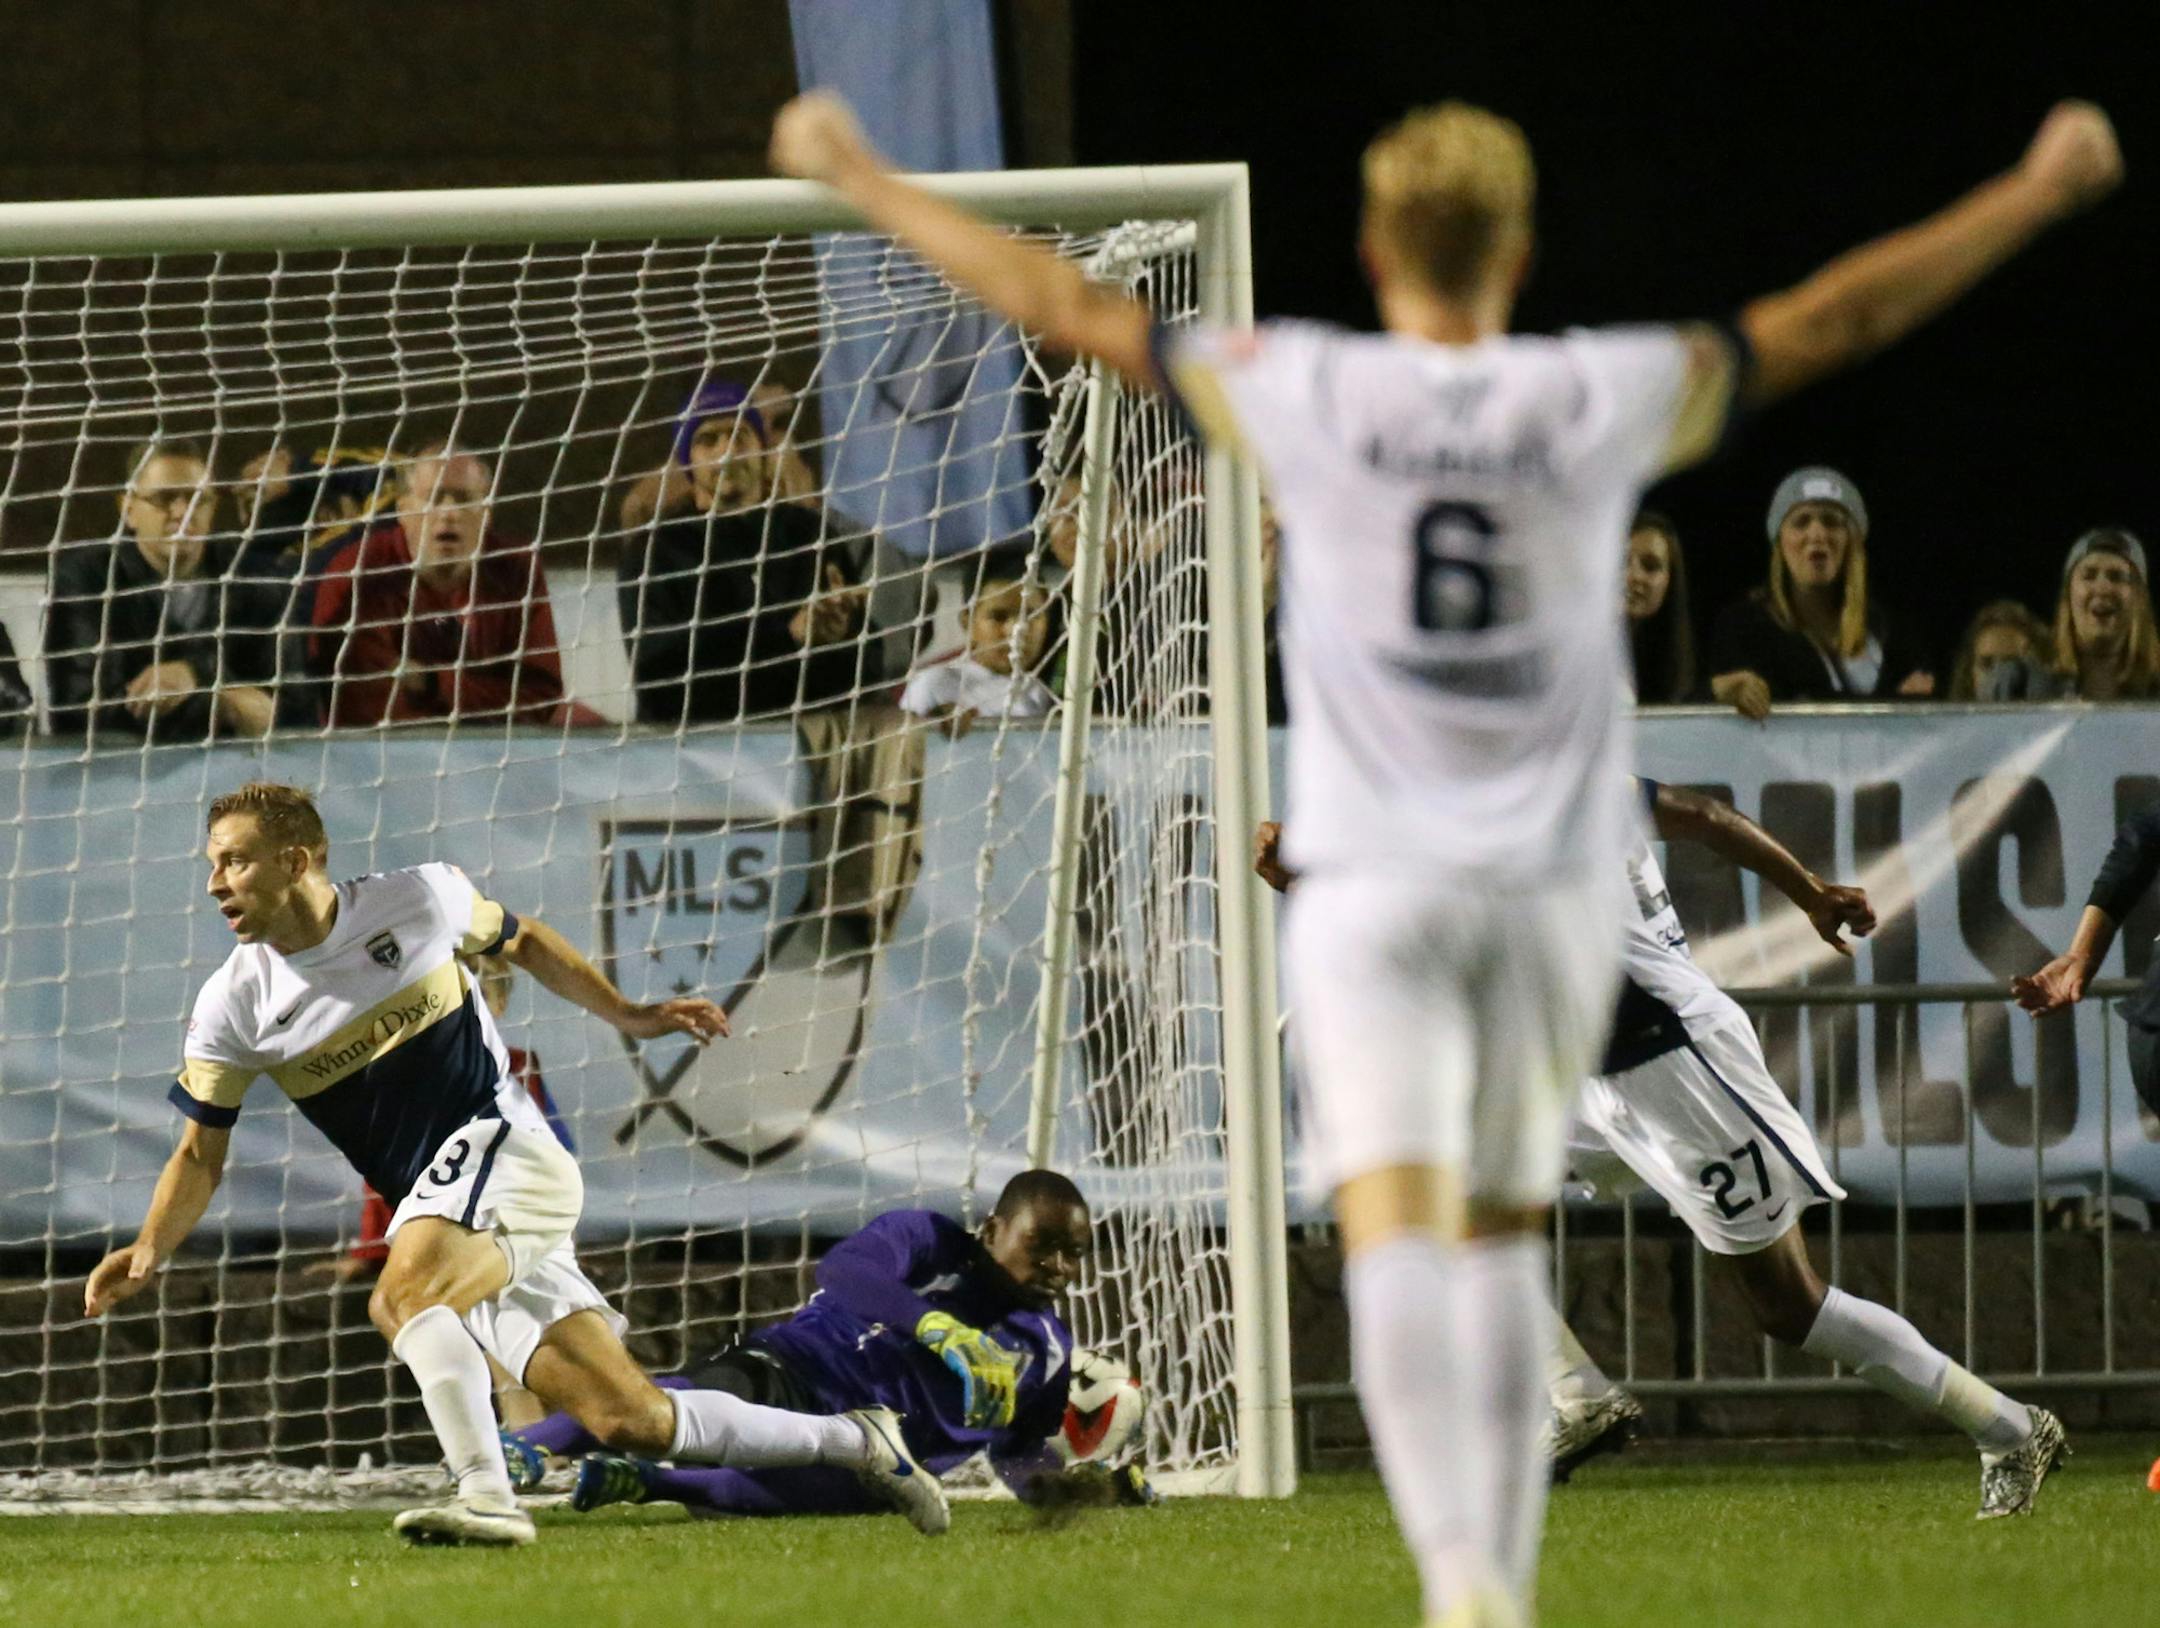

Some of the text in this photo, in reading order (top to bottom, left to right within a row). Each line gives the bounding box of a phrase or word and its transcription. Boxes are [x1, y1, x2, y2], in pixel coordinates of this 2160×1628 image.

[1412, 499, 1497, 635] 6
[625, 846, 771, 916] MLS
[302, 994, 441, 1079] Winn Dixie
[429, 1138, 470, 1186] 3
[1700, 1139, 1772, 1219] 27
